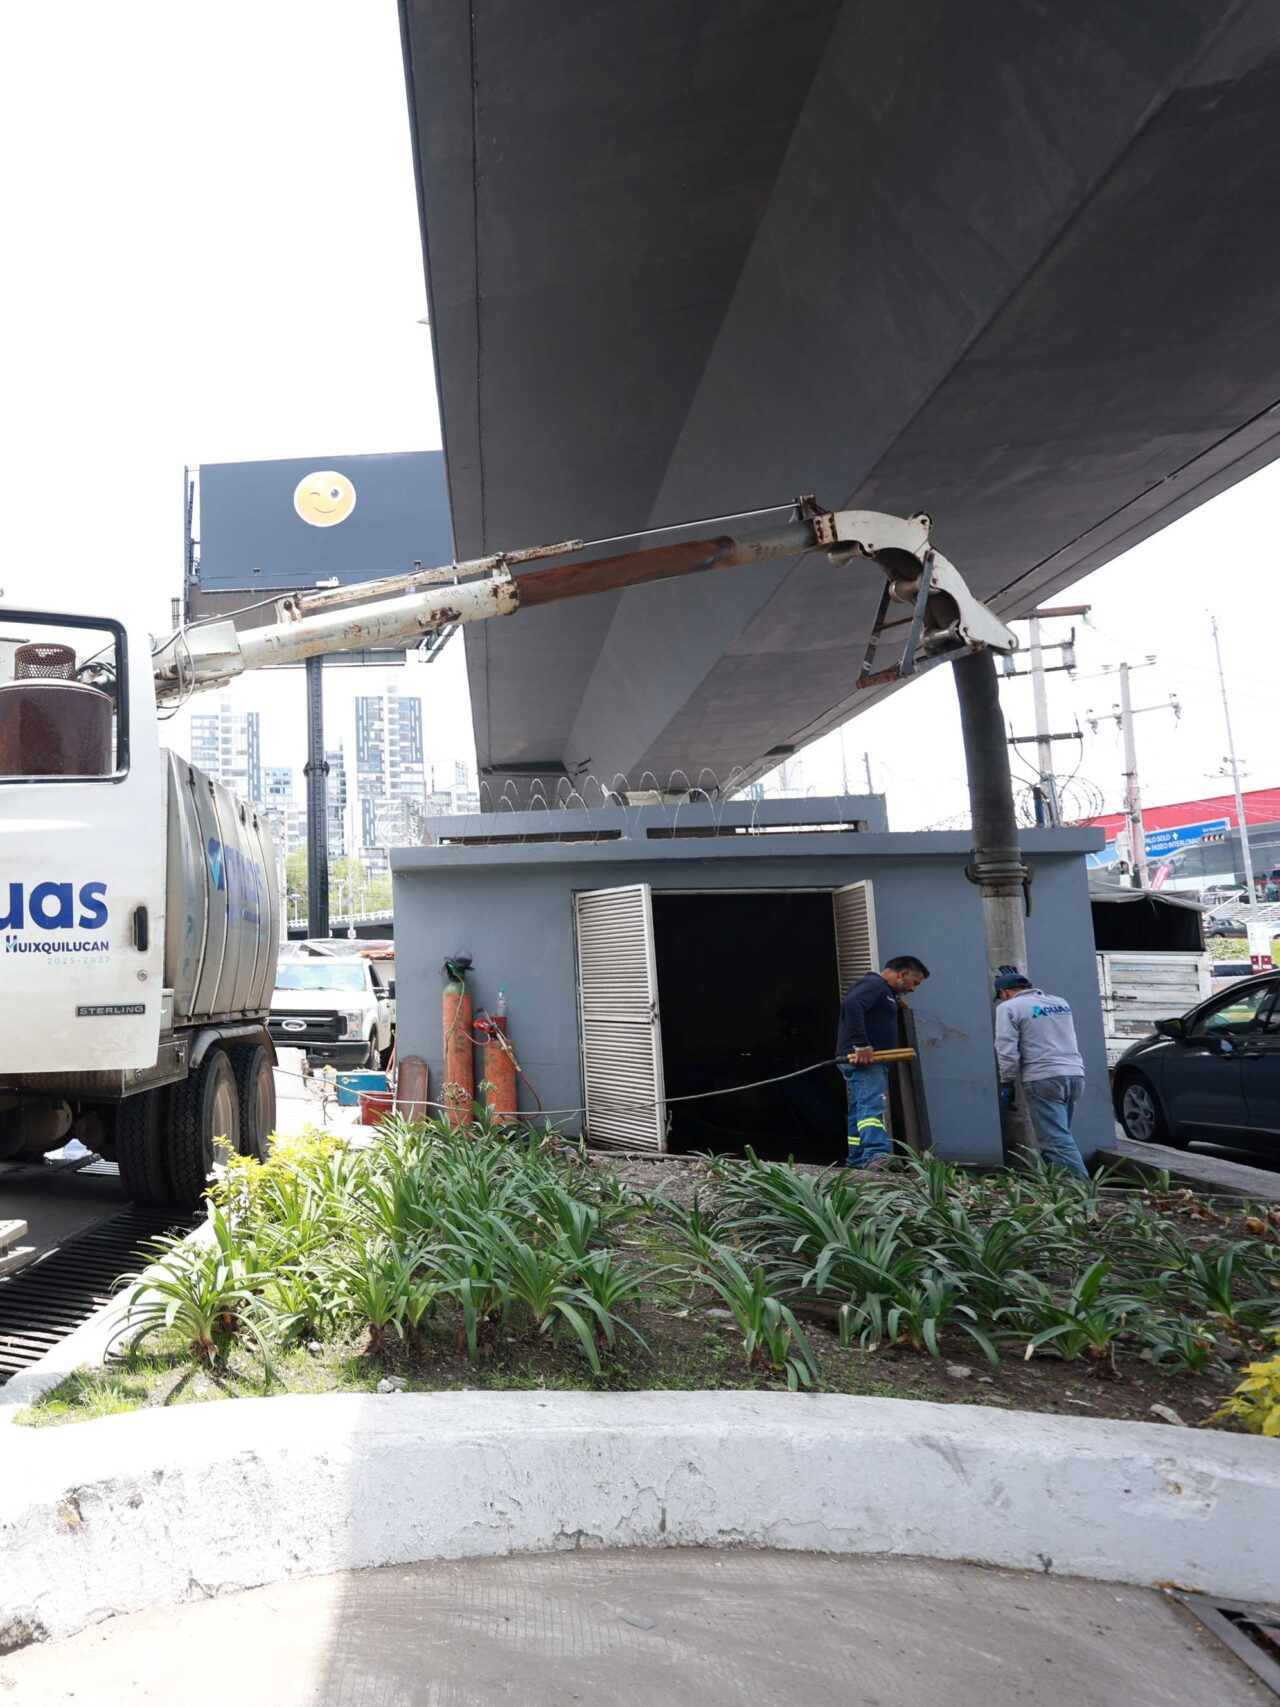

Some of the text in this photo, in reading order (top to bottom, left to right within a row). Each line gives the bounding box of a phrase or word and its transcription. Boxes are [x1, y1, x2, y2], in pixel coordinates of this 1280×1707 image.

[1157, 834, 1171, 842] SOLO
[1151, 843, 1168, 851] PASEO
[5, 935, 110, 955] HUIXQUILUCAN
[47, 955, 111, 966] 2025-2027
[79, 1005, 145, 1016] STERLING
